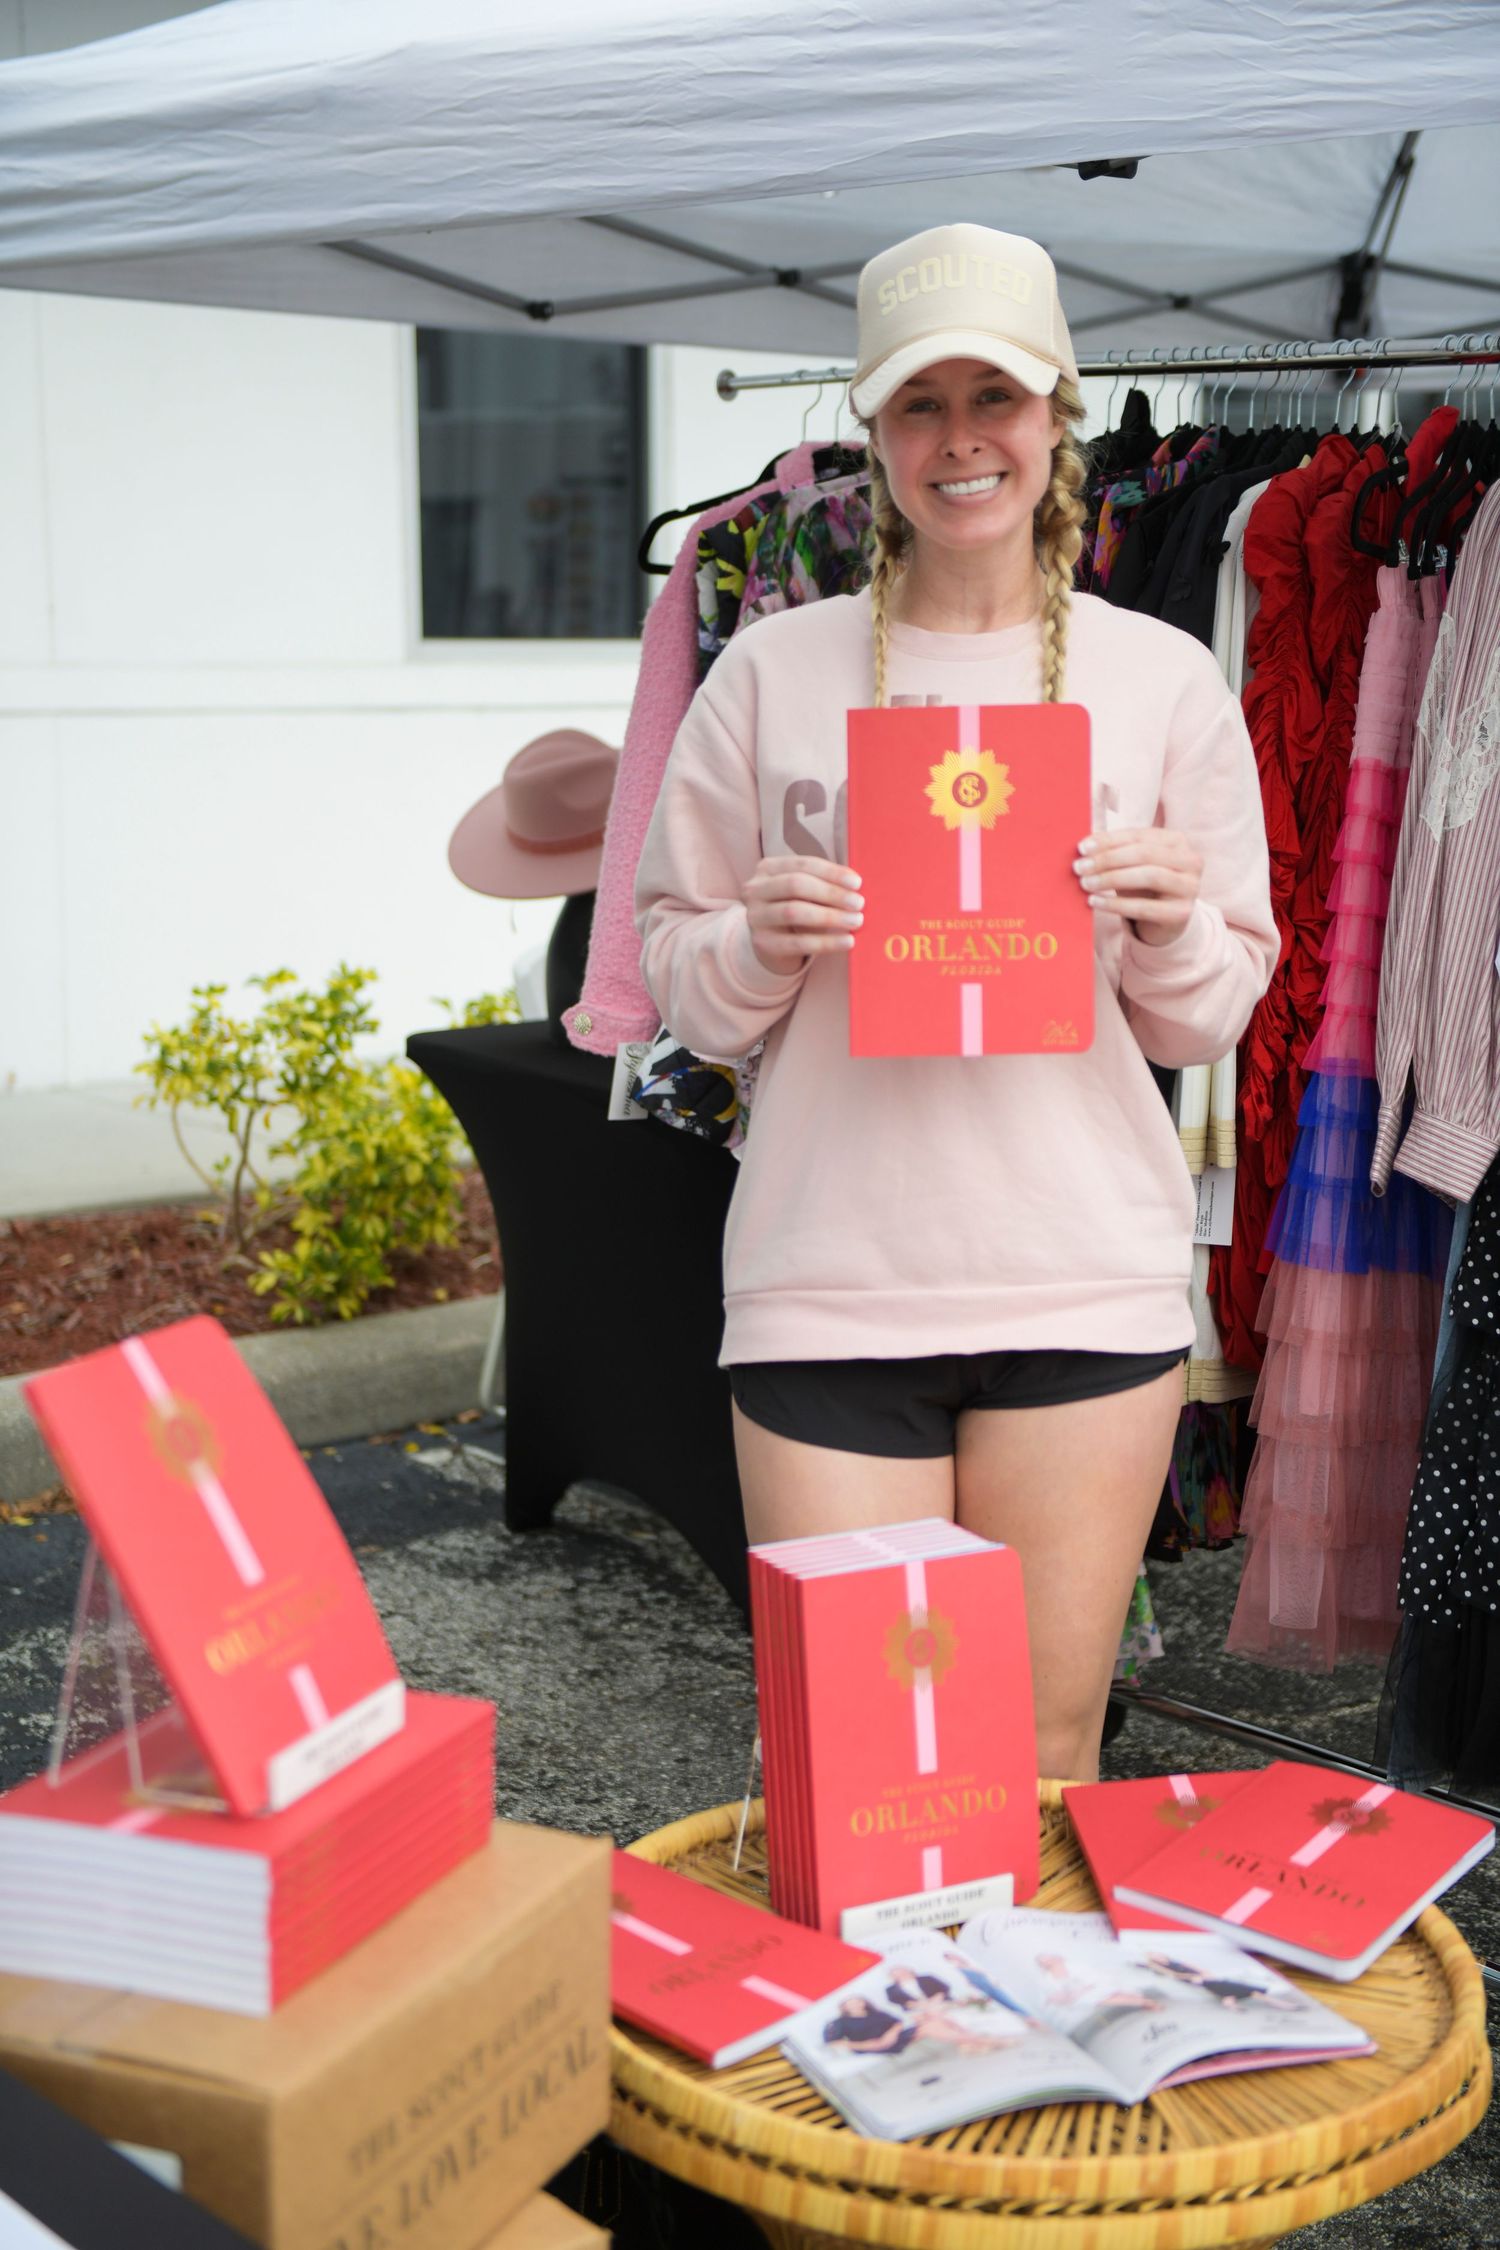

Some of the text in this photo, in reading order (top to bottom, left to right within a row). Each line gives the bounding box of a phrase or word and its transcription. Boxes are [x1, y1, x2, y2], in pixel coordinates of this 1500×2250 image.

[877, 255, 1033, 315] SCOUTED
[920, 918, 1025, 929] THE SCOUT GUIDE
[884, 932, 1059, 961] ORLANDO
[940, 964, 1002, 976] FLORIDA
[850, 1784, 1008, 1838] ORLANDO
[877, 1887, 985, 1922] THE SCOUT GUIDE
[499, 2026, 598, 2141] LOCAL
